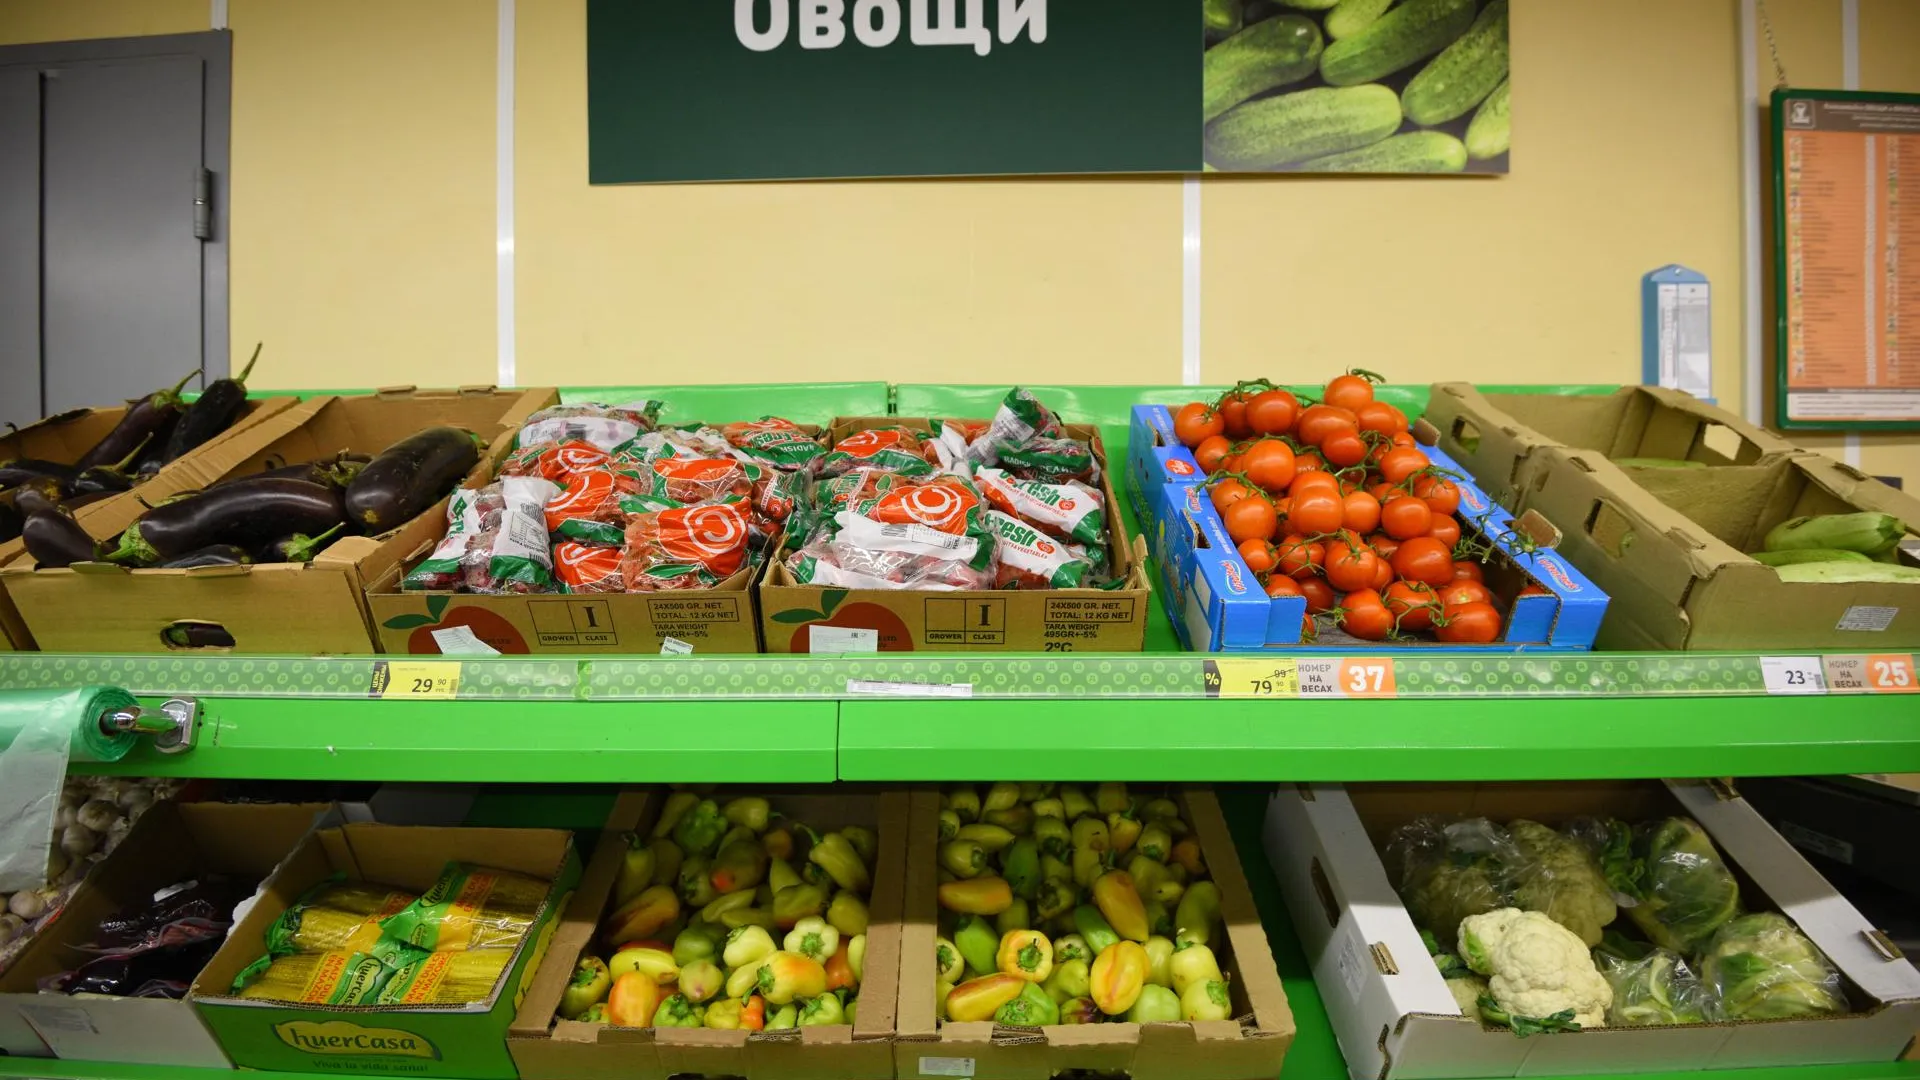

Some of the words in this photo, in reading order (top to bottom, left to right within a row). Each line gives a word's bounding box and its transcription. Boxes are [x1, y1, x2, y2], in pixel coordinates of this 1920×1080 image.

[733, 0, 1047, 56] Овощи
[690, 611, 700, 619] 12
[701, 611, 715, 619] KG
[1111, 611, 1130, 619] NET
[1298, 664, 1331, 673] НОМЕР
[1828, 660, 1858, 668] НОМЕР
[1309, 675, 1322, 683] НА
[1348, 665, 1385, 692] 37
[1784, 670, 1806, 685] 23
[1873, 661, 1909, 687] 25
[411, 678, 433, 693] 29
[1250, 680, 1273, 694] 79
[1301, 684, 1333, 693] ВЕСАХ
[290, 1028, 416, 1050] huerCasa
